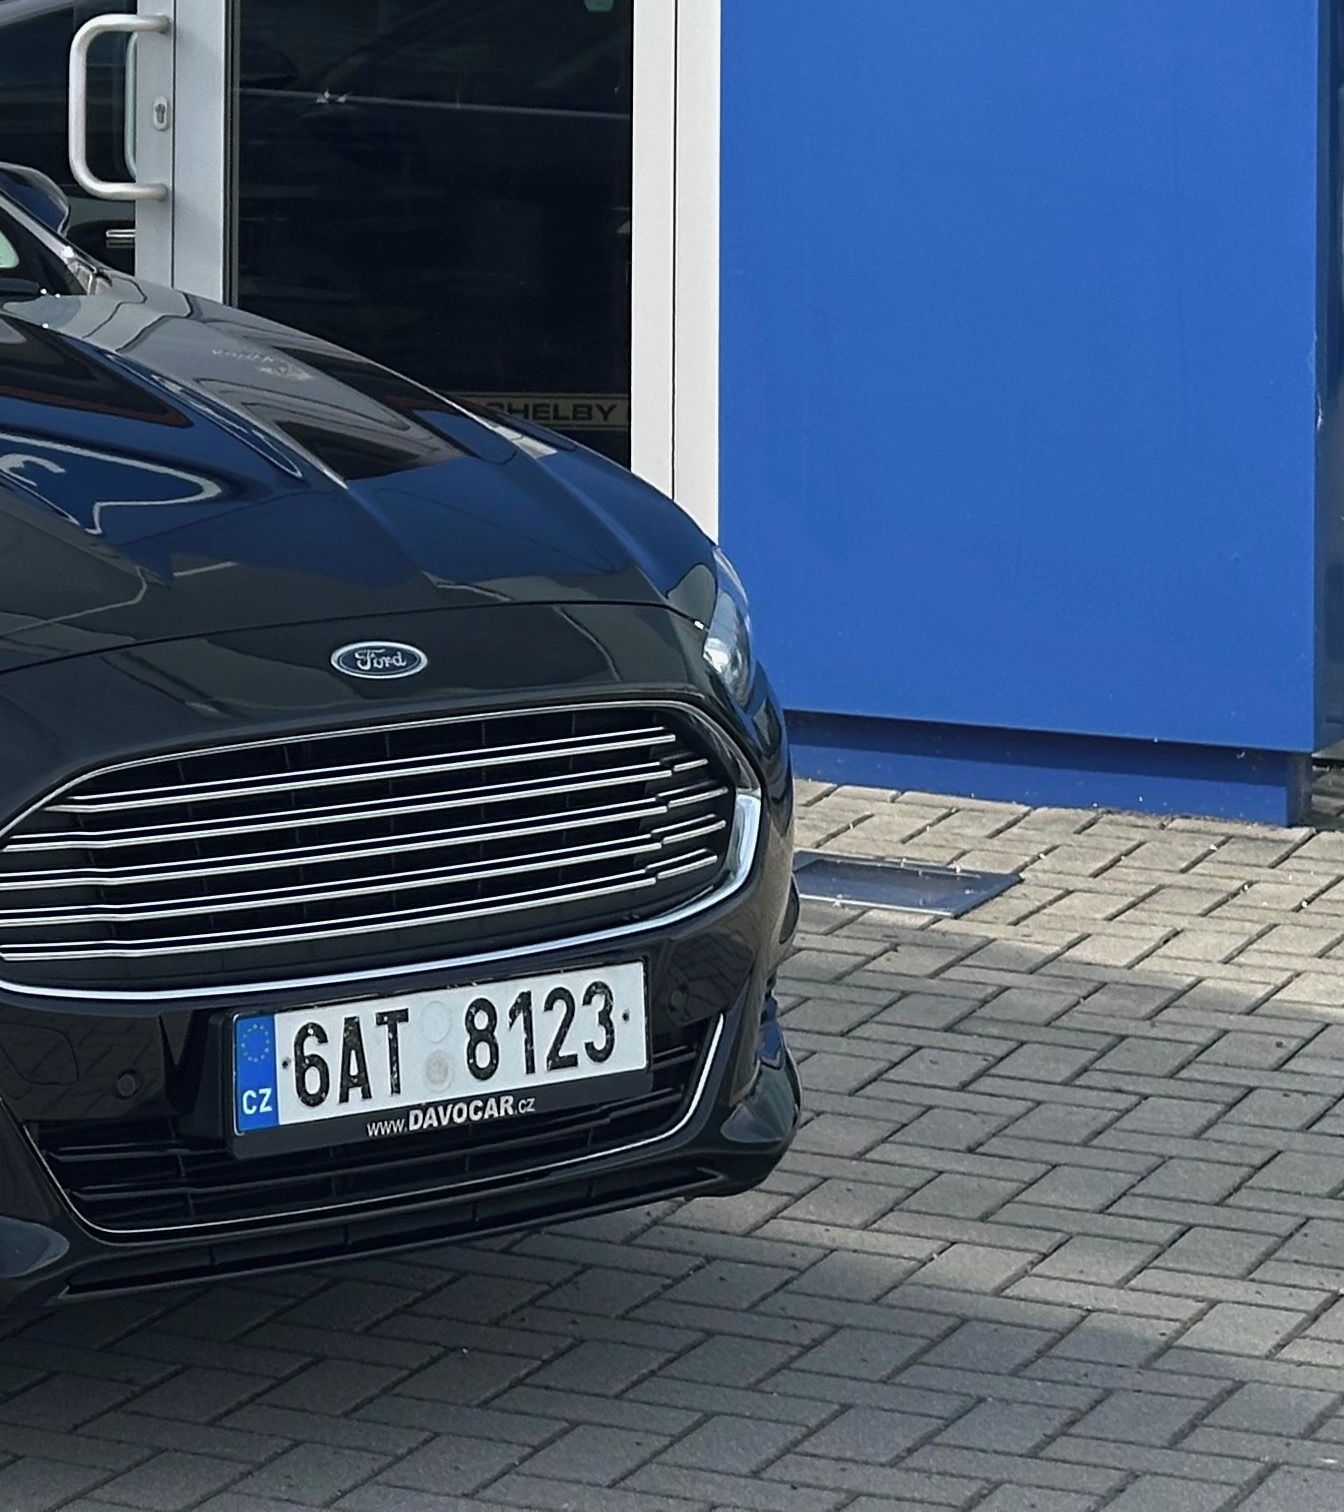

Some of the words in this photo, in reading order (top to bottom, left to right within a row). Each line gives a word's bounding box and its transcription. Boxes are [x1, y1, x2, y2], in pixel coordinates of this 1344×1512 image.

[353, 647, 408, 672] Ford
[292, 1007, 410, 1109] 6AT
[463, 979, 617, 1082] 8123
[242, 1086, 274, 1115] CZ
[366, 1094, 536, 1138] www.DAVOCAR.cz
